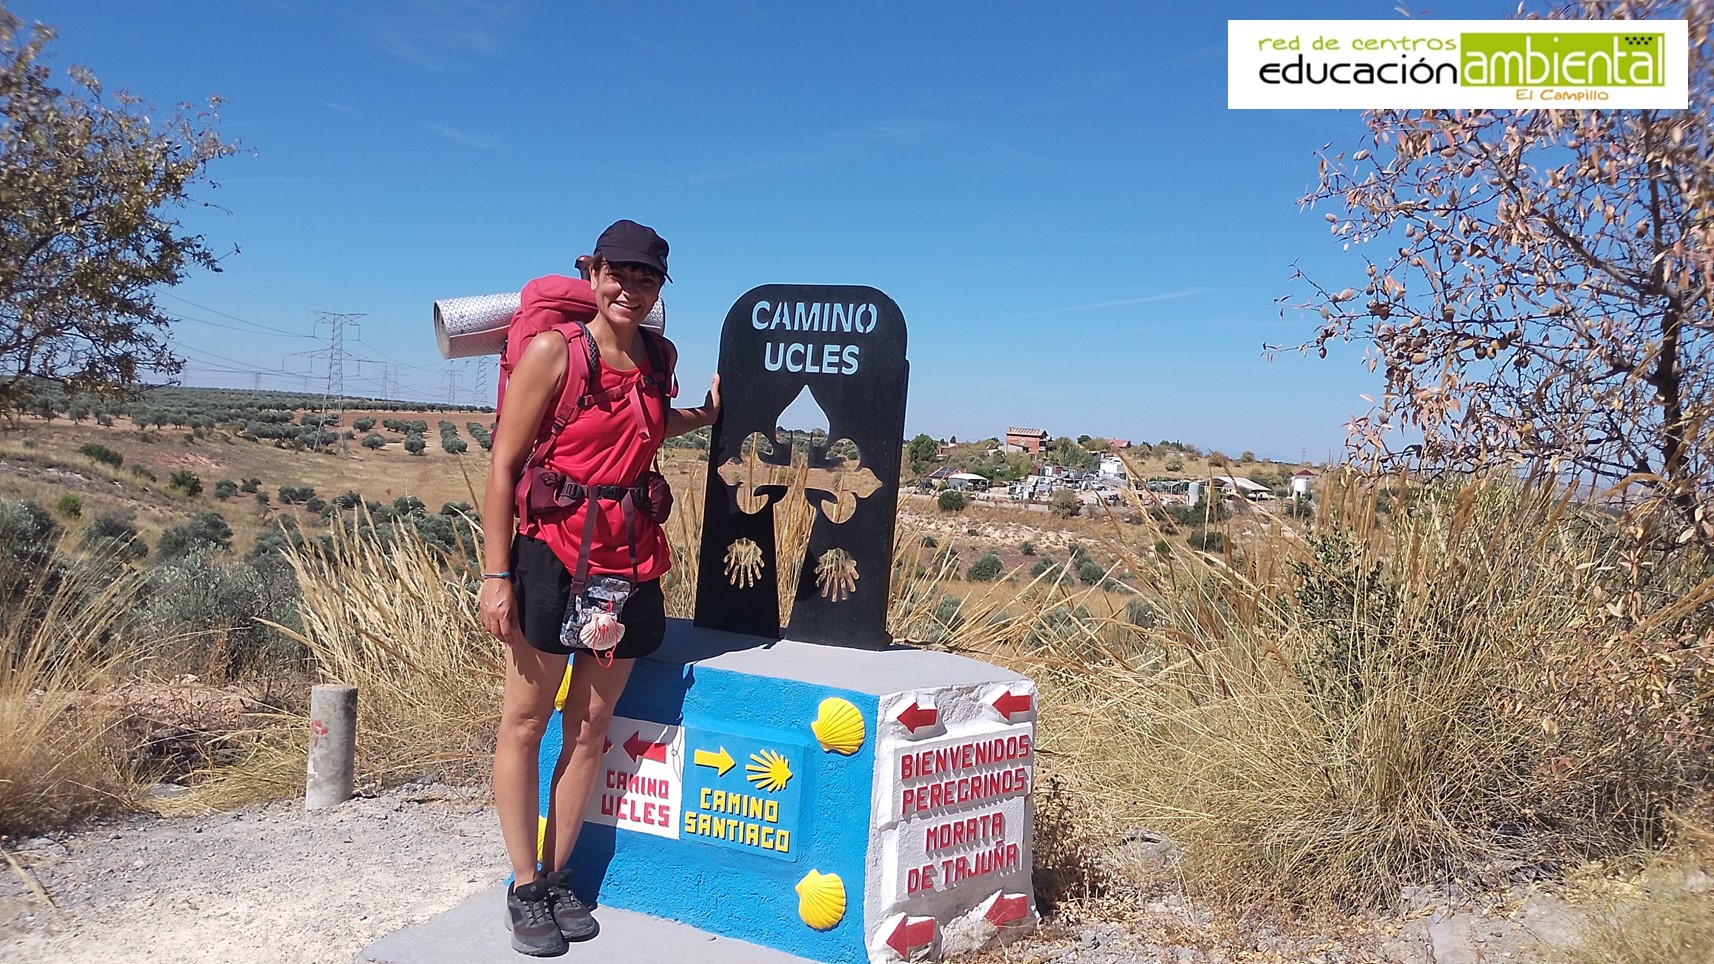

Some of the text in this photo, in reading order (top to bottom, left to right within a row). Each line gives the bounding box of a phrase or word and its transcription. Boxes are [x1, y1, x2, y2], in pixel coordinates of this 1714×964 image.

[752, 300, 878, 334] CAMINO
[764, 342, 860, 375] UCLES
[901, 734, 1030, 780] BIENVENIDOS
[606, 770, 670, 799] CAMINO
[902, 768, 1026, 815] PEREGRINOS
[601, 794, 671, 827] UCLES
[700, 787, 780, 823] CAMINO
[684, 811, 790, 853] SANTIAGO
[925, 812, 1004, 854] MORATA
[907, 840, 1018, 894] DE TAJUÑA
